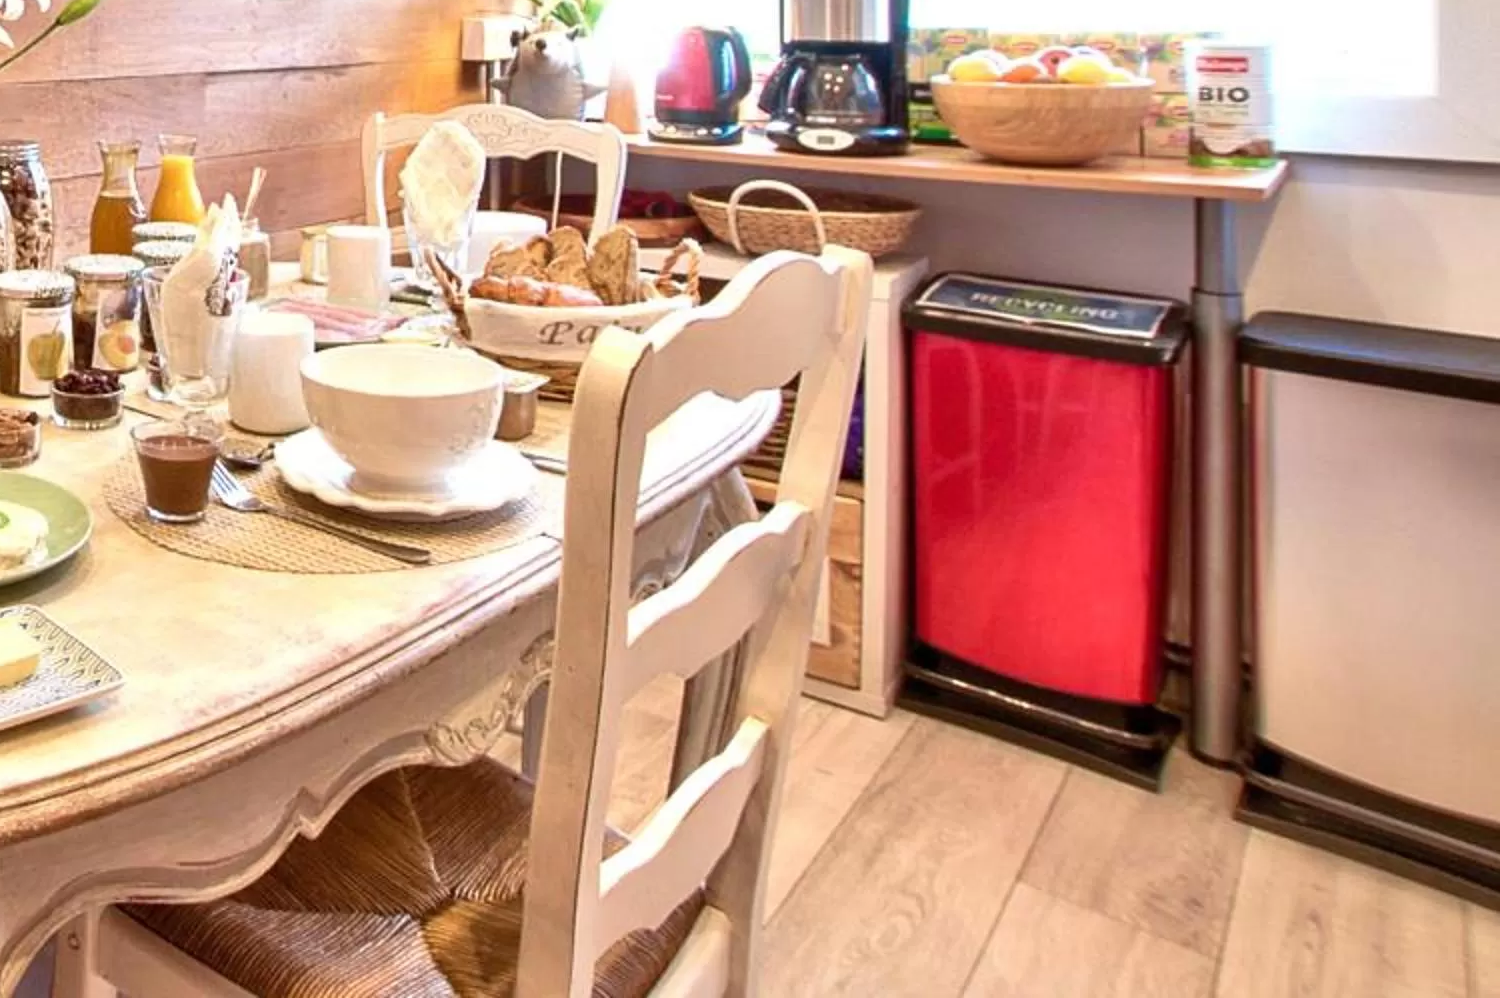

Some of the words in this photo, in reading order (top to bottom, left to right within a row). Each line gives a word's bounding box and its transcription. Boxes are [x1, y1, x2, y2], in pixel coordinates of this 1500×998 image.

[1198, 86, 1250, 103] BIO
[969, 292, 1119, 320] RECYCLING
[539, 319, 644, 345] Pa
